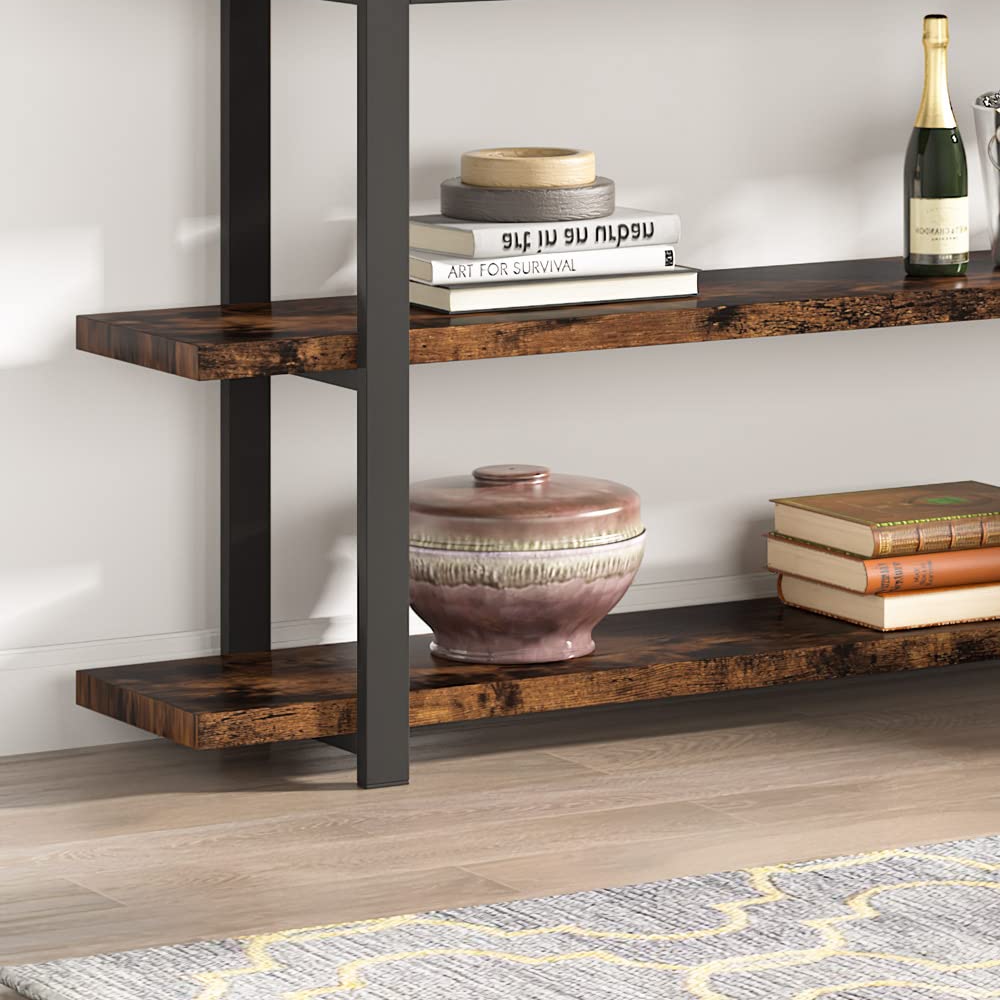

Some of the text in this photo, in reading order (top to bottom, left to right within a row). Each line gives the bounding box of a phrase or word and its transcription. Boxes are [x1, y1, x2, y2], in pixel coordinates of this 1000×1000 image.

[447, 258, 577, 279] ART FOR SURVIVAL
